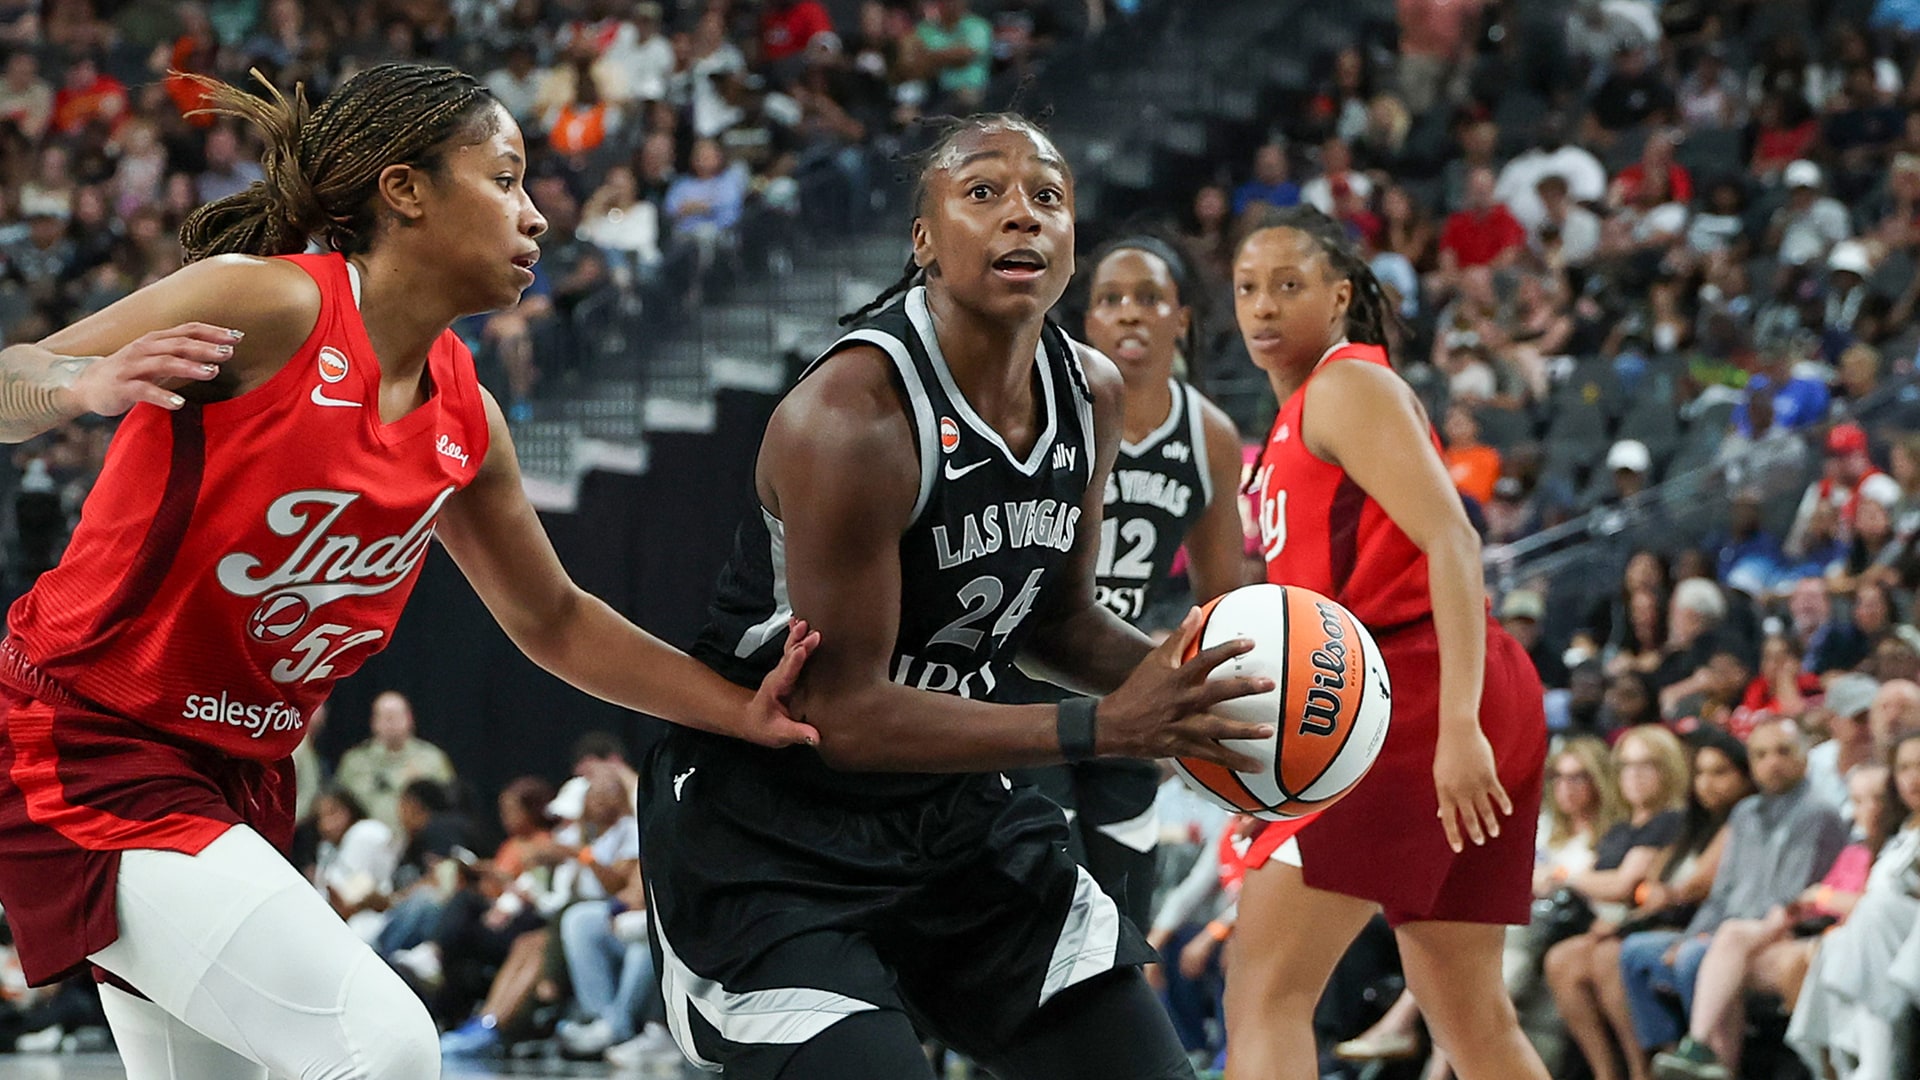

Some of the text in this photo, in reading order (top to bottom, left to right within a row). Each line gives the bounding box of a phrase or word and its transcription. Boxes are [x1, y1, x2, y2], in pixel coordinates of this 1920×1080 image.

[1052, 442, 1077, 472] ally
[931, 504, 1003, 570] LAS
[1095, 517, 1158, 579] 12
[925, 567, 1046, 651] 24
[1298, 601, 1348, 737] Wilson
